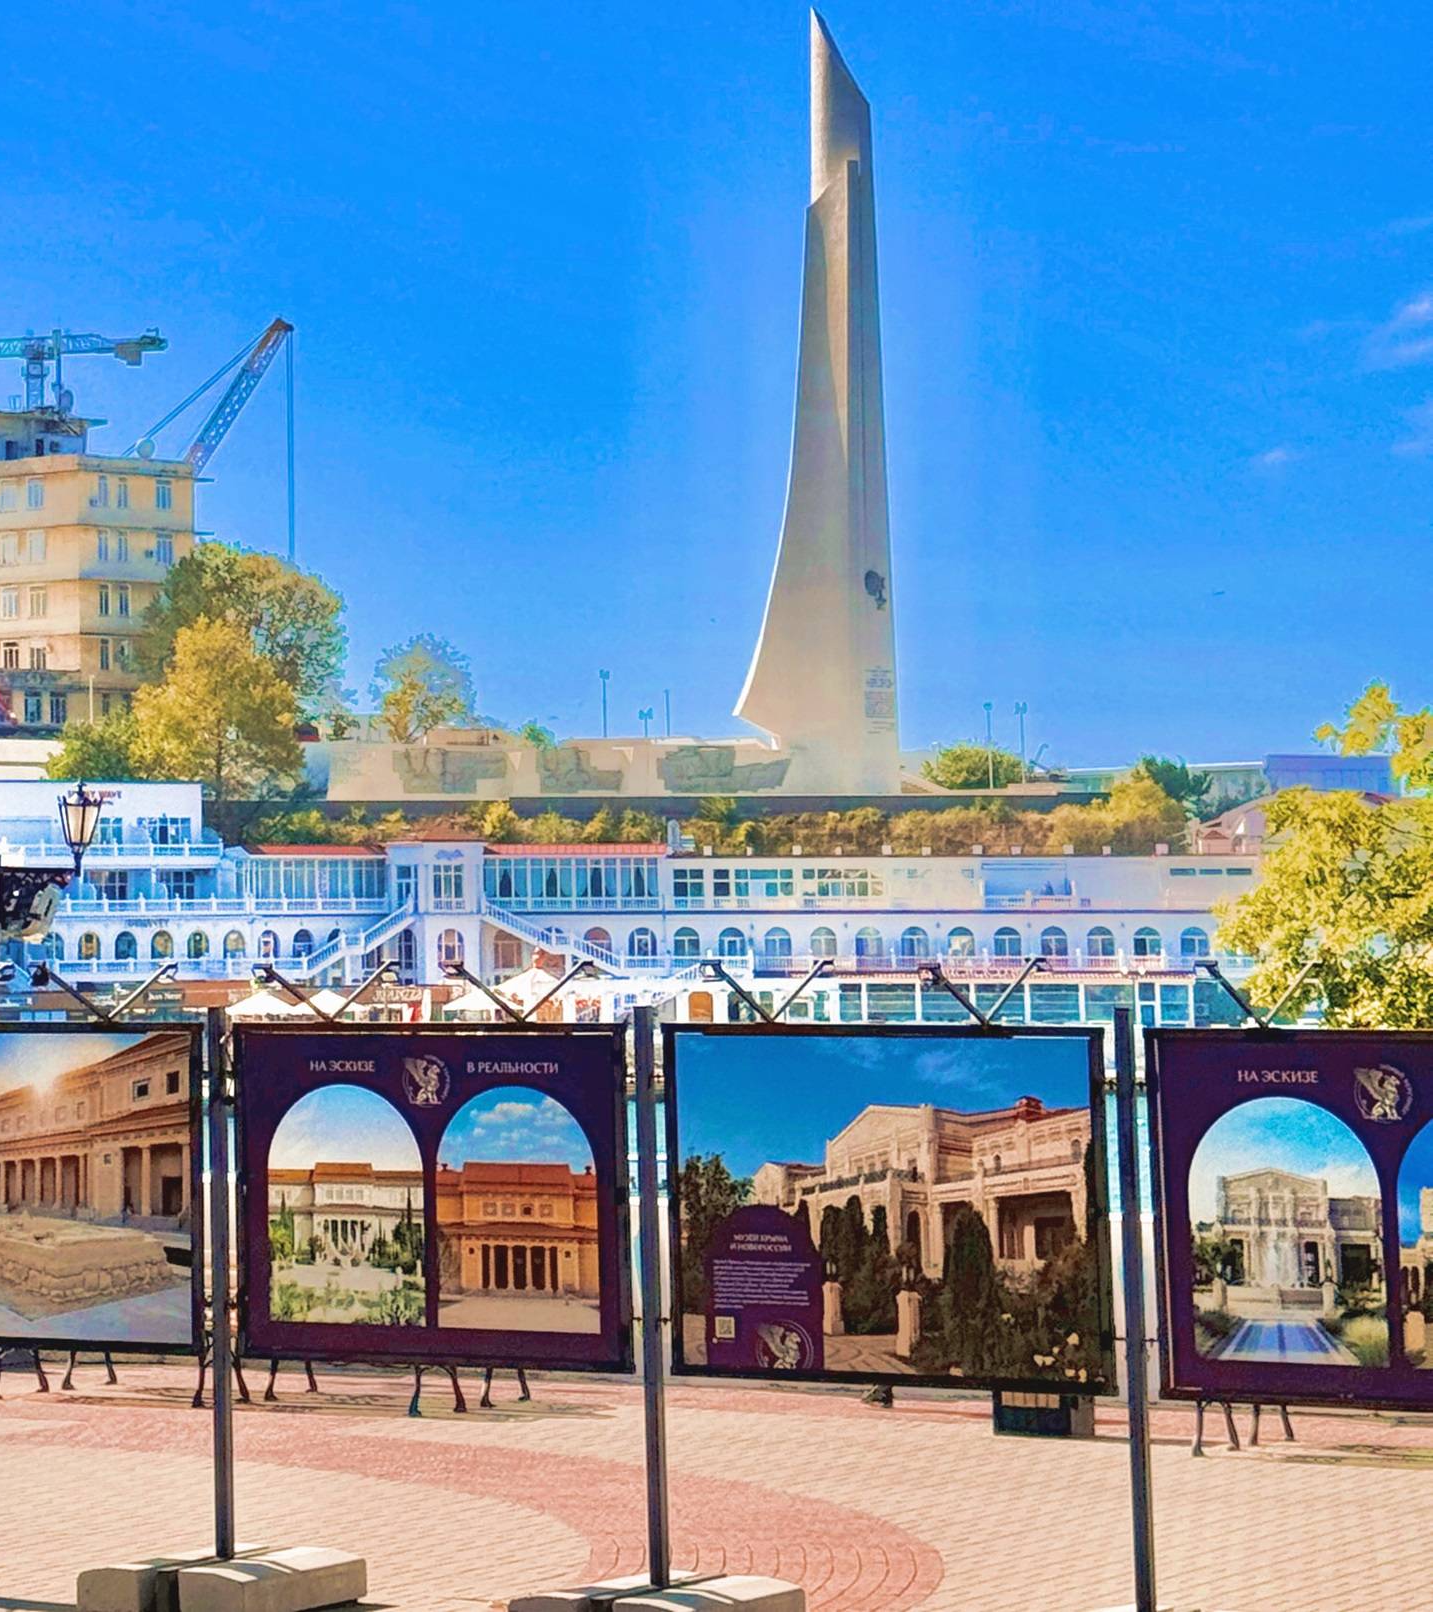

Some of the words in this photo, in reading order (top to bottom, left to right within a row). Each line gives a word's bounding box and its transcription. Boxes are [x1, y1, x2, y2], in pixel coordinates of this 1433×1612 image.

[310, 1060, 328, 1071] НА
[329, 1060, 375, 1072] ЭСКИЗЕ
[467, 1061, 475, 1072] В
[478, 1061, 559, 1074] РЕАЛЬНОСТИ
[1237, 1070, 1259, 1082] НА
[1261, 1070, 1319, 1084] ЭСКИЗЕ
